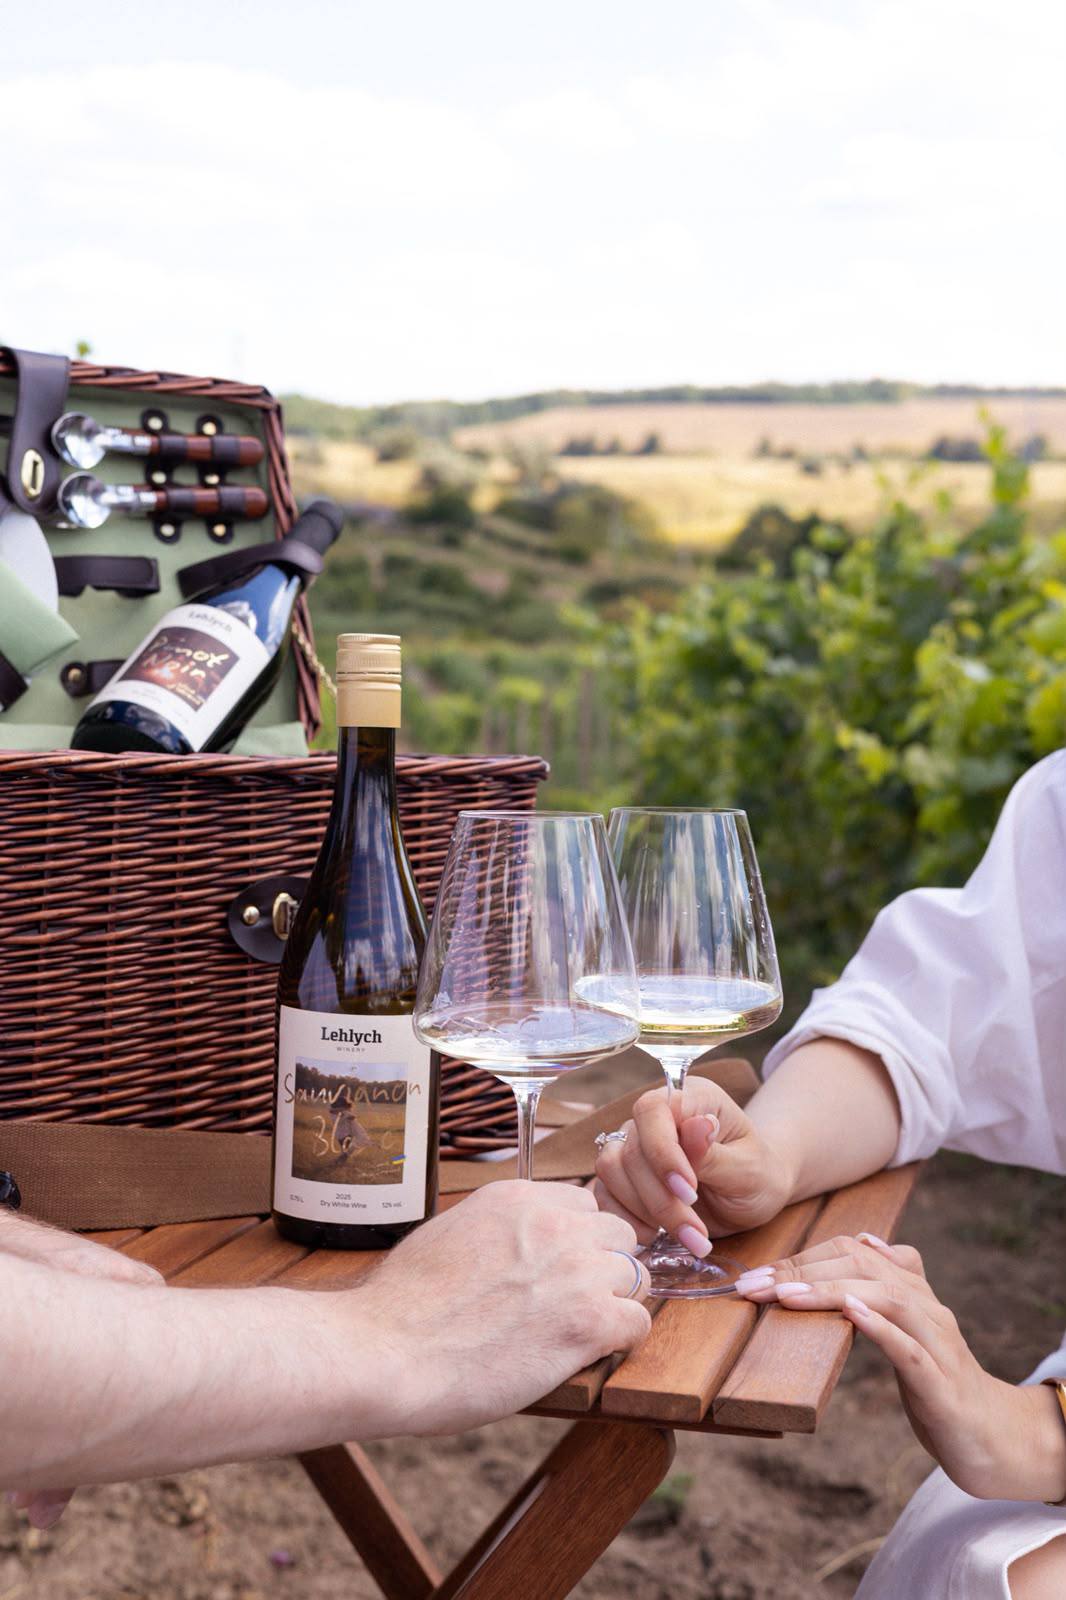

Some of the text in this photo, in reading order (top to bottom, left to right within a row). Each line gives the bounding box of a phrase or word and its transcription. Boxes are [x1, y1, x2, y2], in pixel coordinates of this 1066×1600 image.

[148, 636, 229, 668] Pinot
[143, 653, 207, 679] Noir
[320, 1026, 383, 1047] Lehlych
[312, 1111, 393, 1157] Blac
[320, 1200, 331, 1208] Dry
[331, 1200, 350, 1209] White
